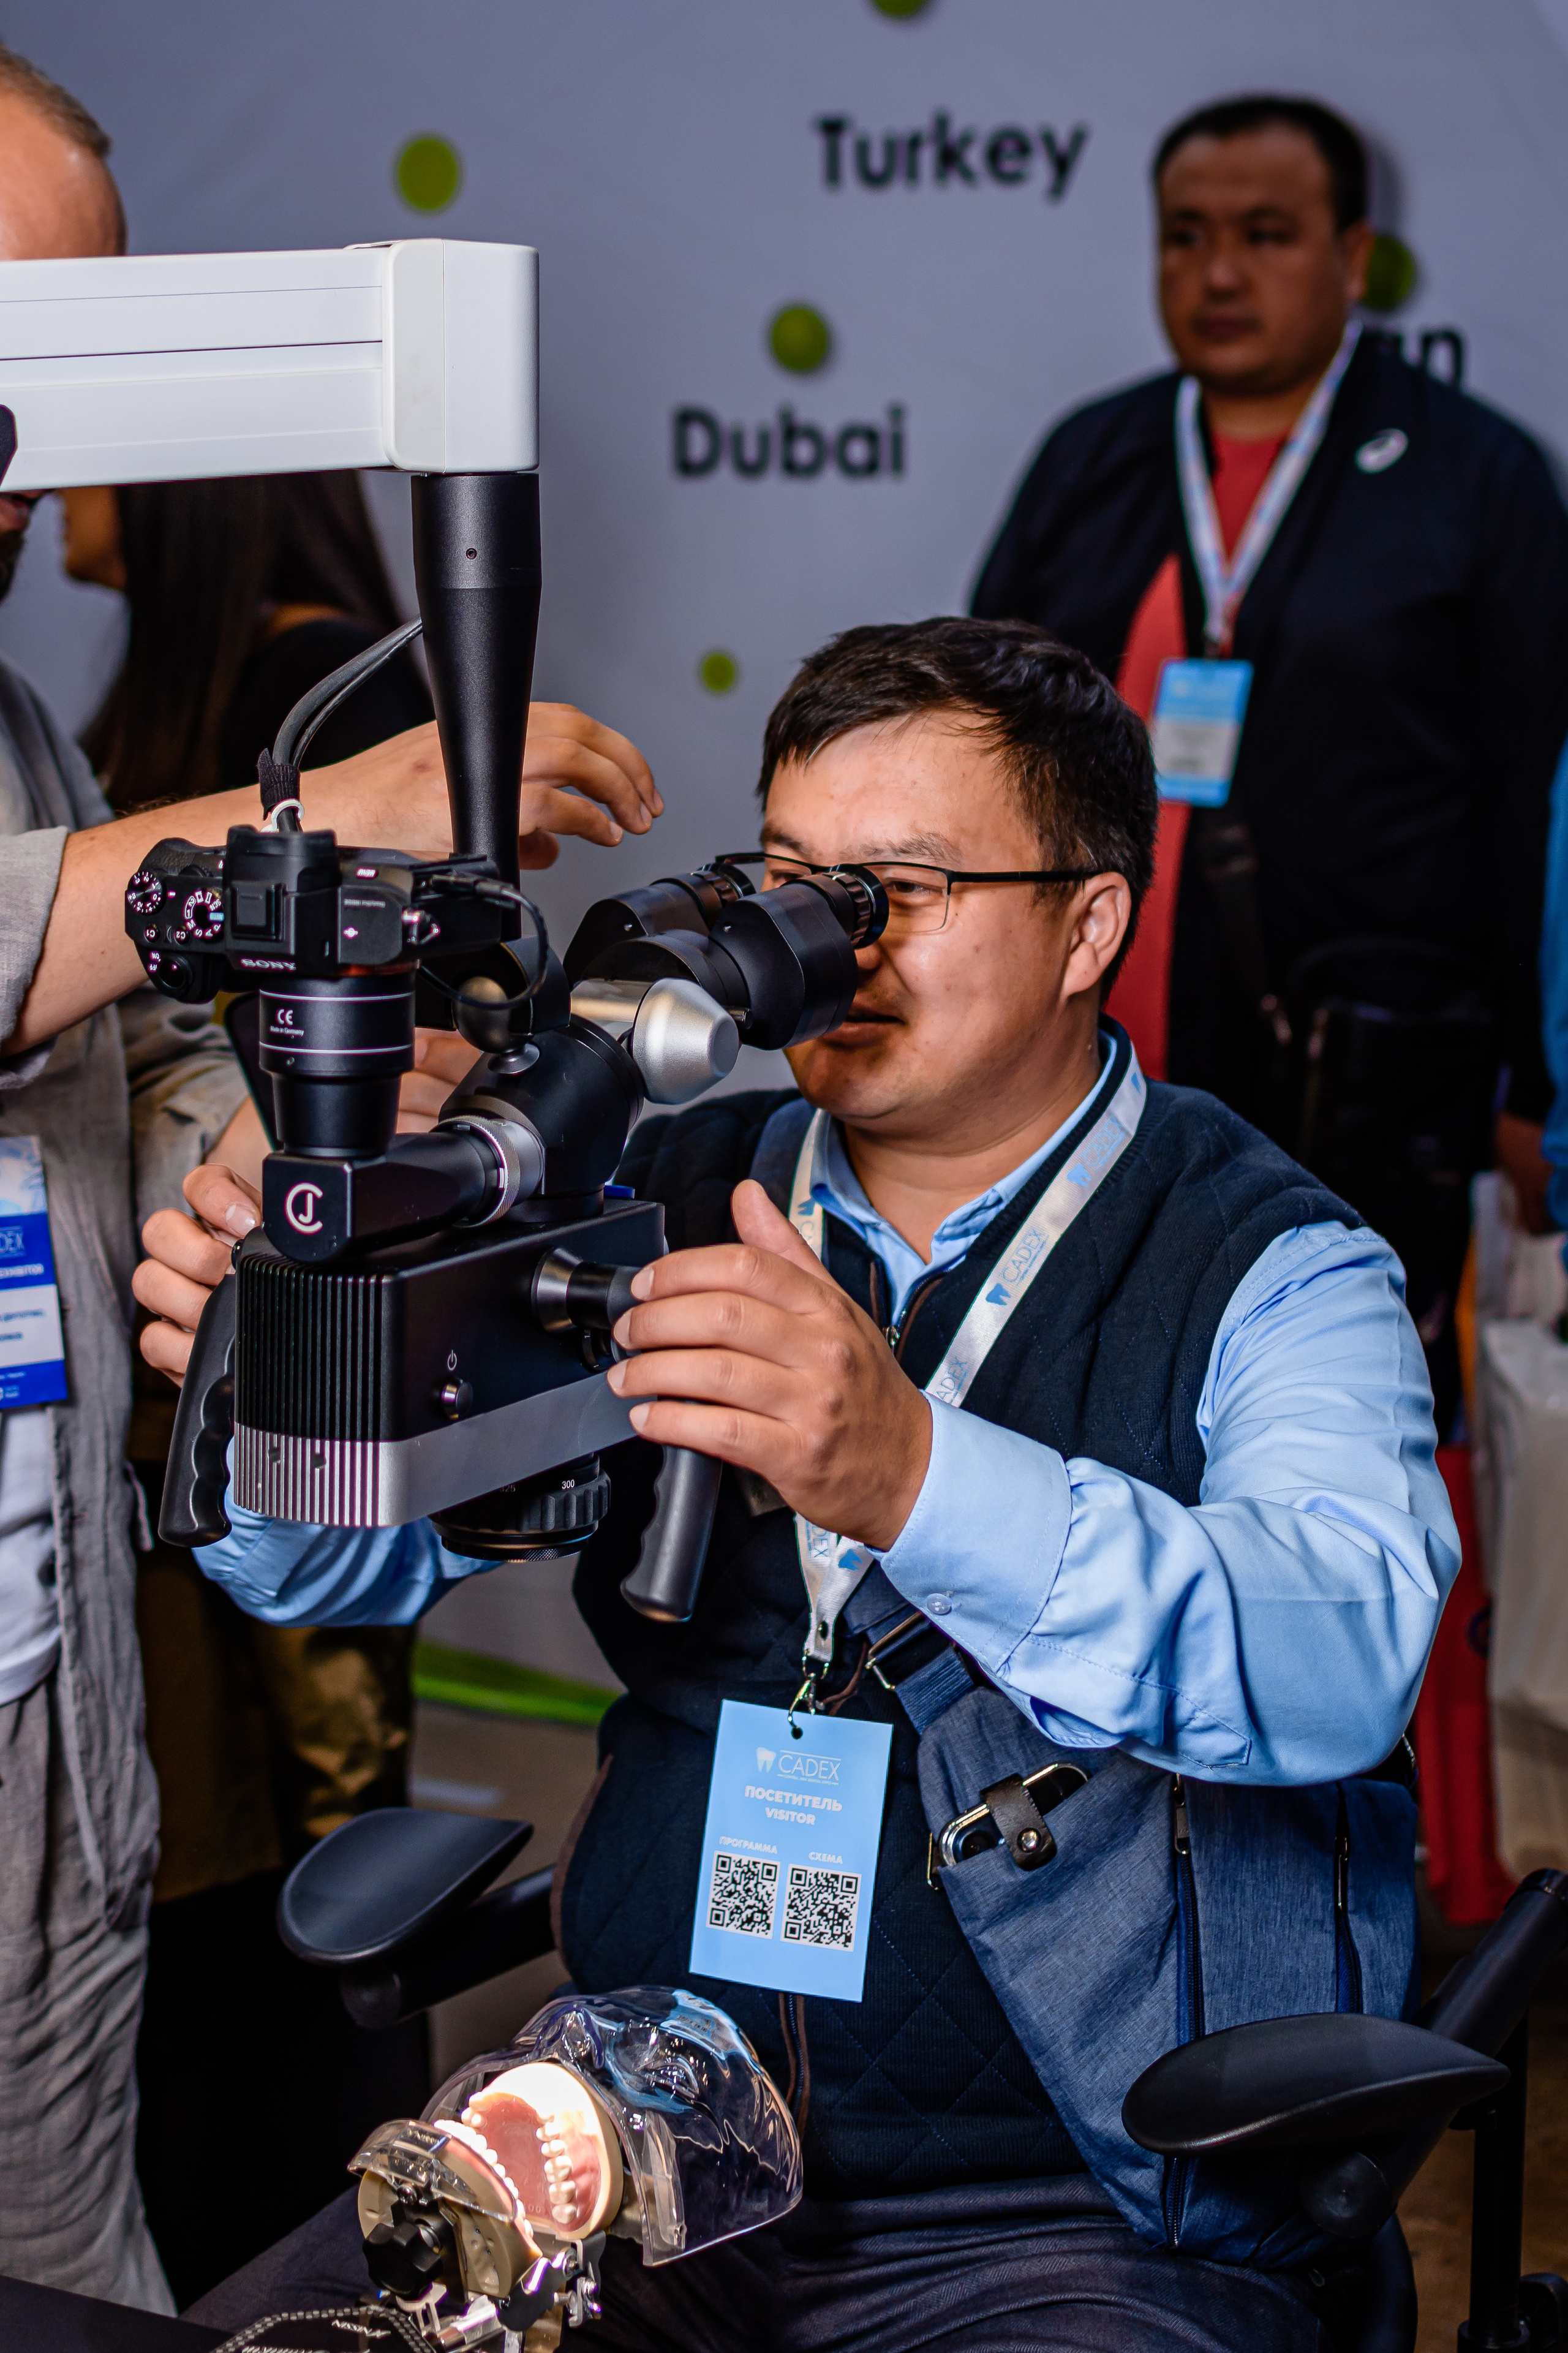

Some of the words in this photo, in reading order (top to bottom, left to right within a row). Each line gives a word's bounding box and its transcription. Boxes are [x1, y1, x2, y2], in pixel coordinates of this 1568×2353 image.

[815, 108, 1088, 202] Turkey
[671, 403, 905, 479] Dubai
[146, 929, 156, 939] C1
[175, 931, 186, 940] C2
[241, 958, 296, 971] SONY
[277, 1008, 293, 1025] CE
[284, 1027, 304, 1037] Germany
[1002, 1227, 1046, 1283] CADEX
[936, 1355, 968, 1400] ADEX
[562, 1479, 575, 1489] 300
[812, 1525, 829, 1558] DEX
[778, 1754, 841, 1781] CADEX
[744, 1785, 843, 1812] ПОСЕТИТЕЛЬ
[766, 1807, 816, 1826] VISITOR
[719, 1836, 778, 1855] ПРОГРАММА
[808, 1851, 843, 1865] СХЕМА
